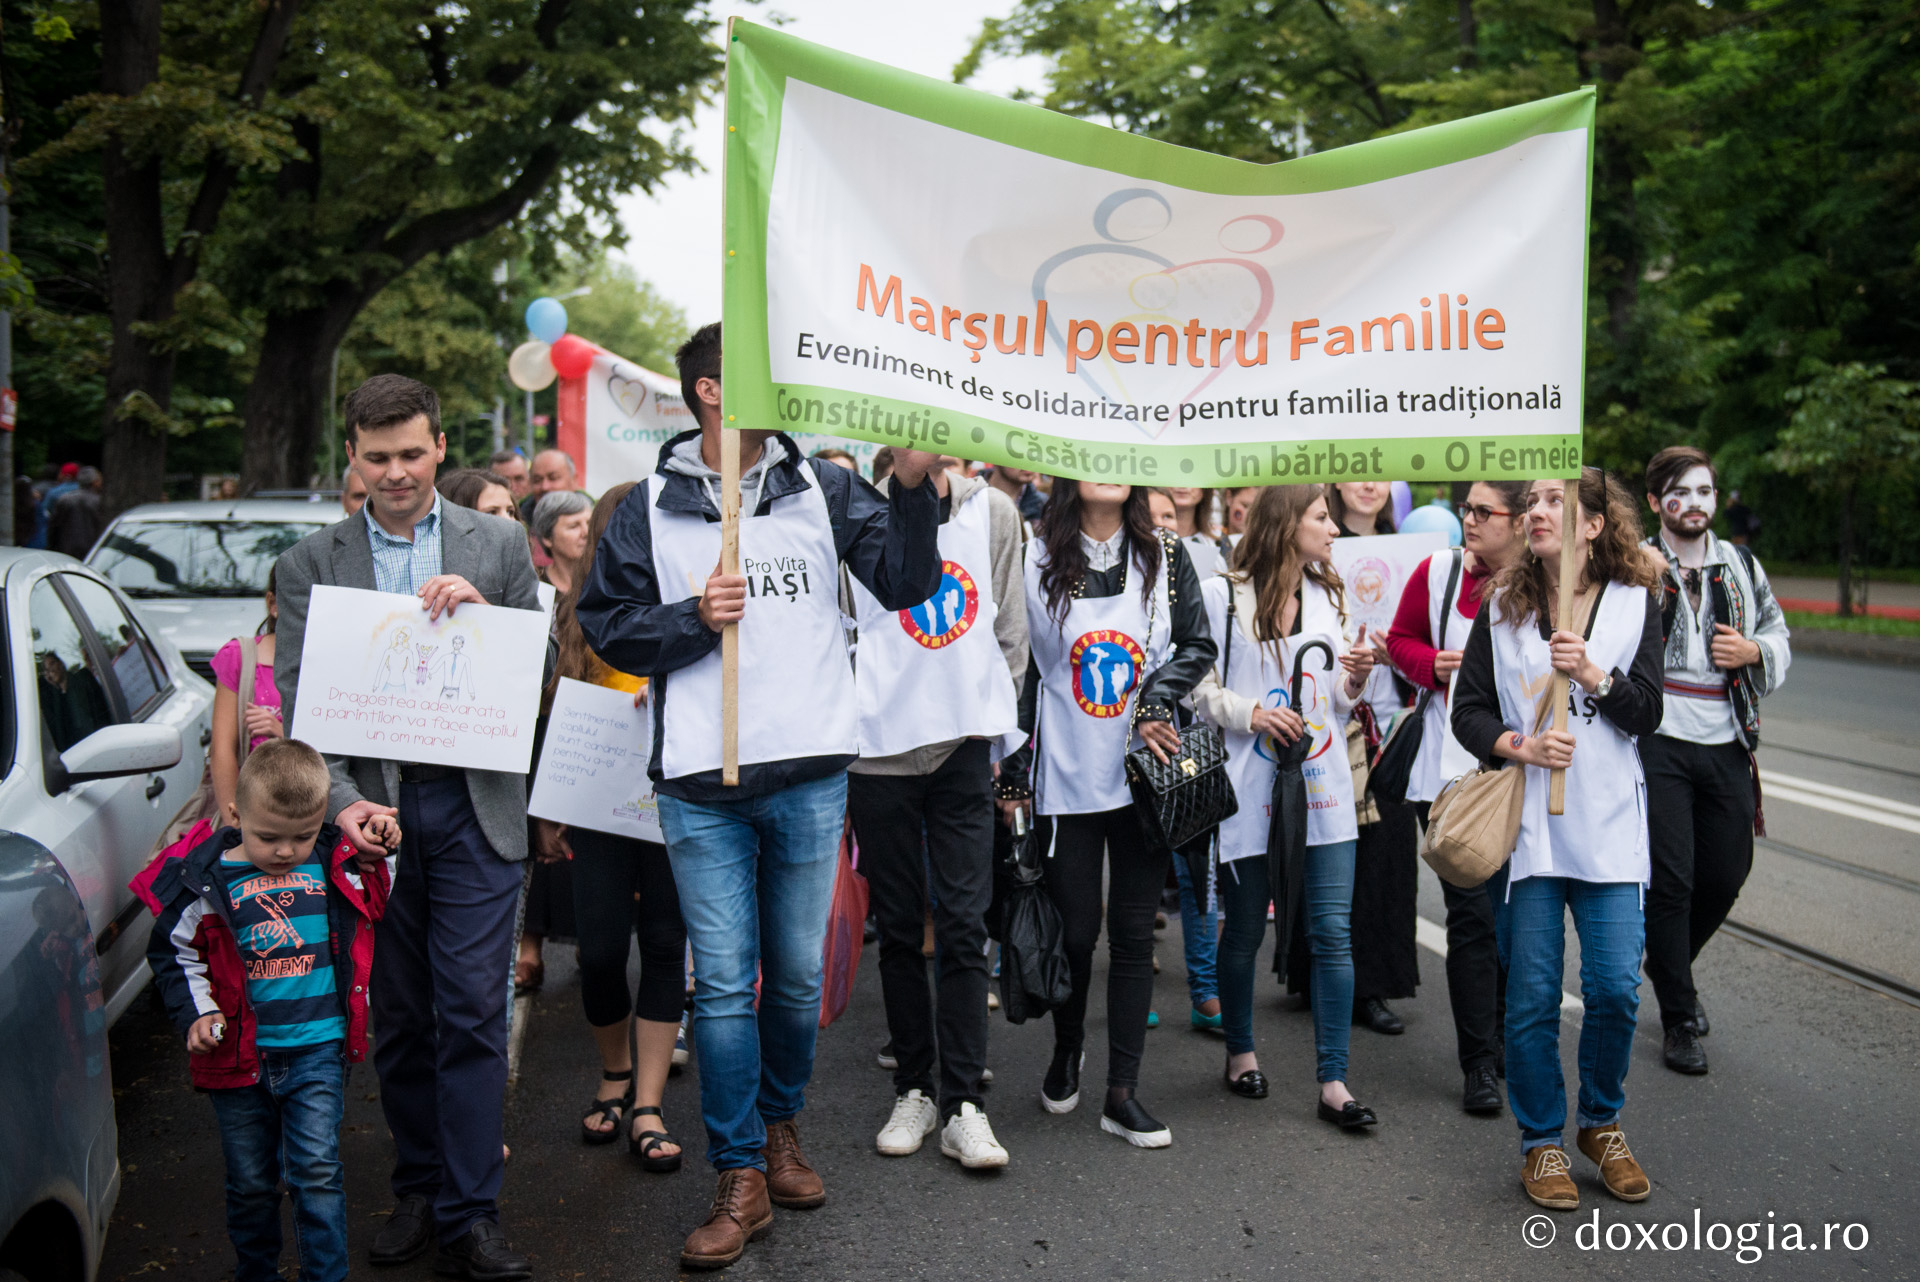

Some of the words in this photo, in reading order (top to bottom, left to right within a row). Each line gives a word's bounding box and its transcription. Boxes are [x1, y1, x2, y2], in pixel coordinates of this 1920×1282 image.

[856, 262, 1048, 363] Marșul
[1065, 318, 1268, 374] pentru
[1290, 293, 1506, 361] Familie
[796, 332, 954, 390] Eveniment
[961, 376, 995, 401] de
[1001, 389, 1170, 422] solidarizare
[1178, 394, 1279, 427] pentru
[1288, 388, 1389, 416] familia
[1396, 384, 1562, 418] tradițională
[777, 388, 951, 449] Constituție
[1004, 429, 1158, 477] Căsătorie
[1213, 447, 1260, 478] Un
[1271, 444, 1383, 477] bărbat
[1444, 441, 1470, 472] O
[1479, 438, 1579, 472] Femeie
[744, 557, 772, 573] Pro
[774, 556, 808, 573] Vita
[747, 572, 811, 603] IAȘI
[328, 686, 416, 709] Dragostea
[420, 698, 506, 719] adevarata
[312, 706, 322, 717] a
[407, 716, 426, 727] va
[432, 716, 469, 732] face
[473, 723, 518, 739] copilul
[563, 706, 629, 731] Sentimentele
[366, 729, 386, 741] un
[390, 732, 410, 743] om
[413, 734, 456, 748] mare!
[550, 760, 597, 777] construi
[552, 747, 591, 763] pentru
[242, 874, 309, 898] BASEBALL
